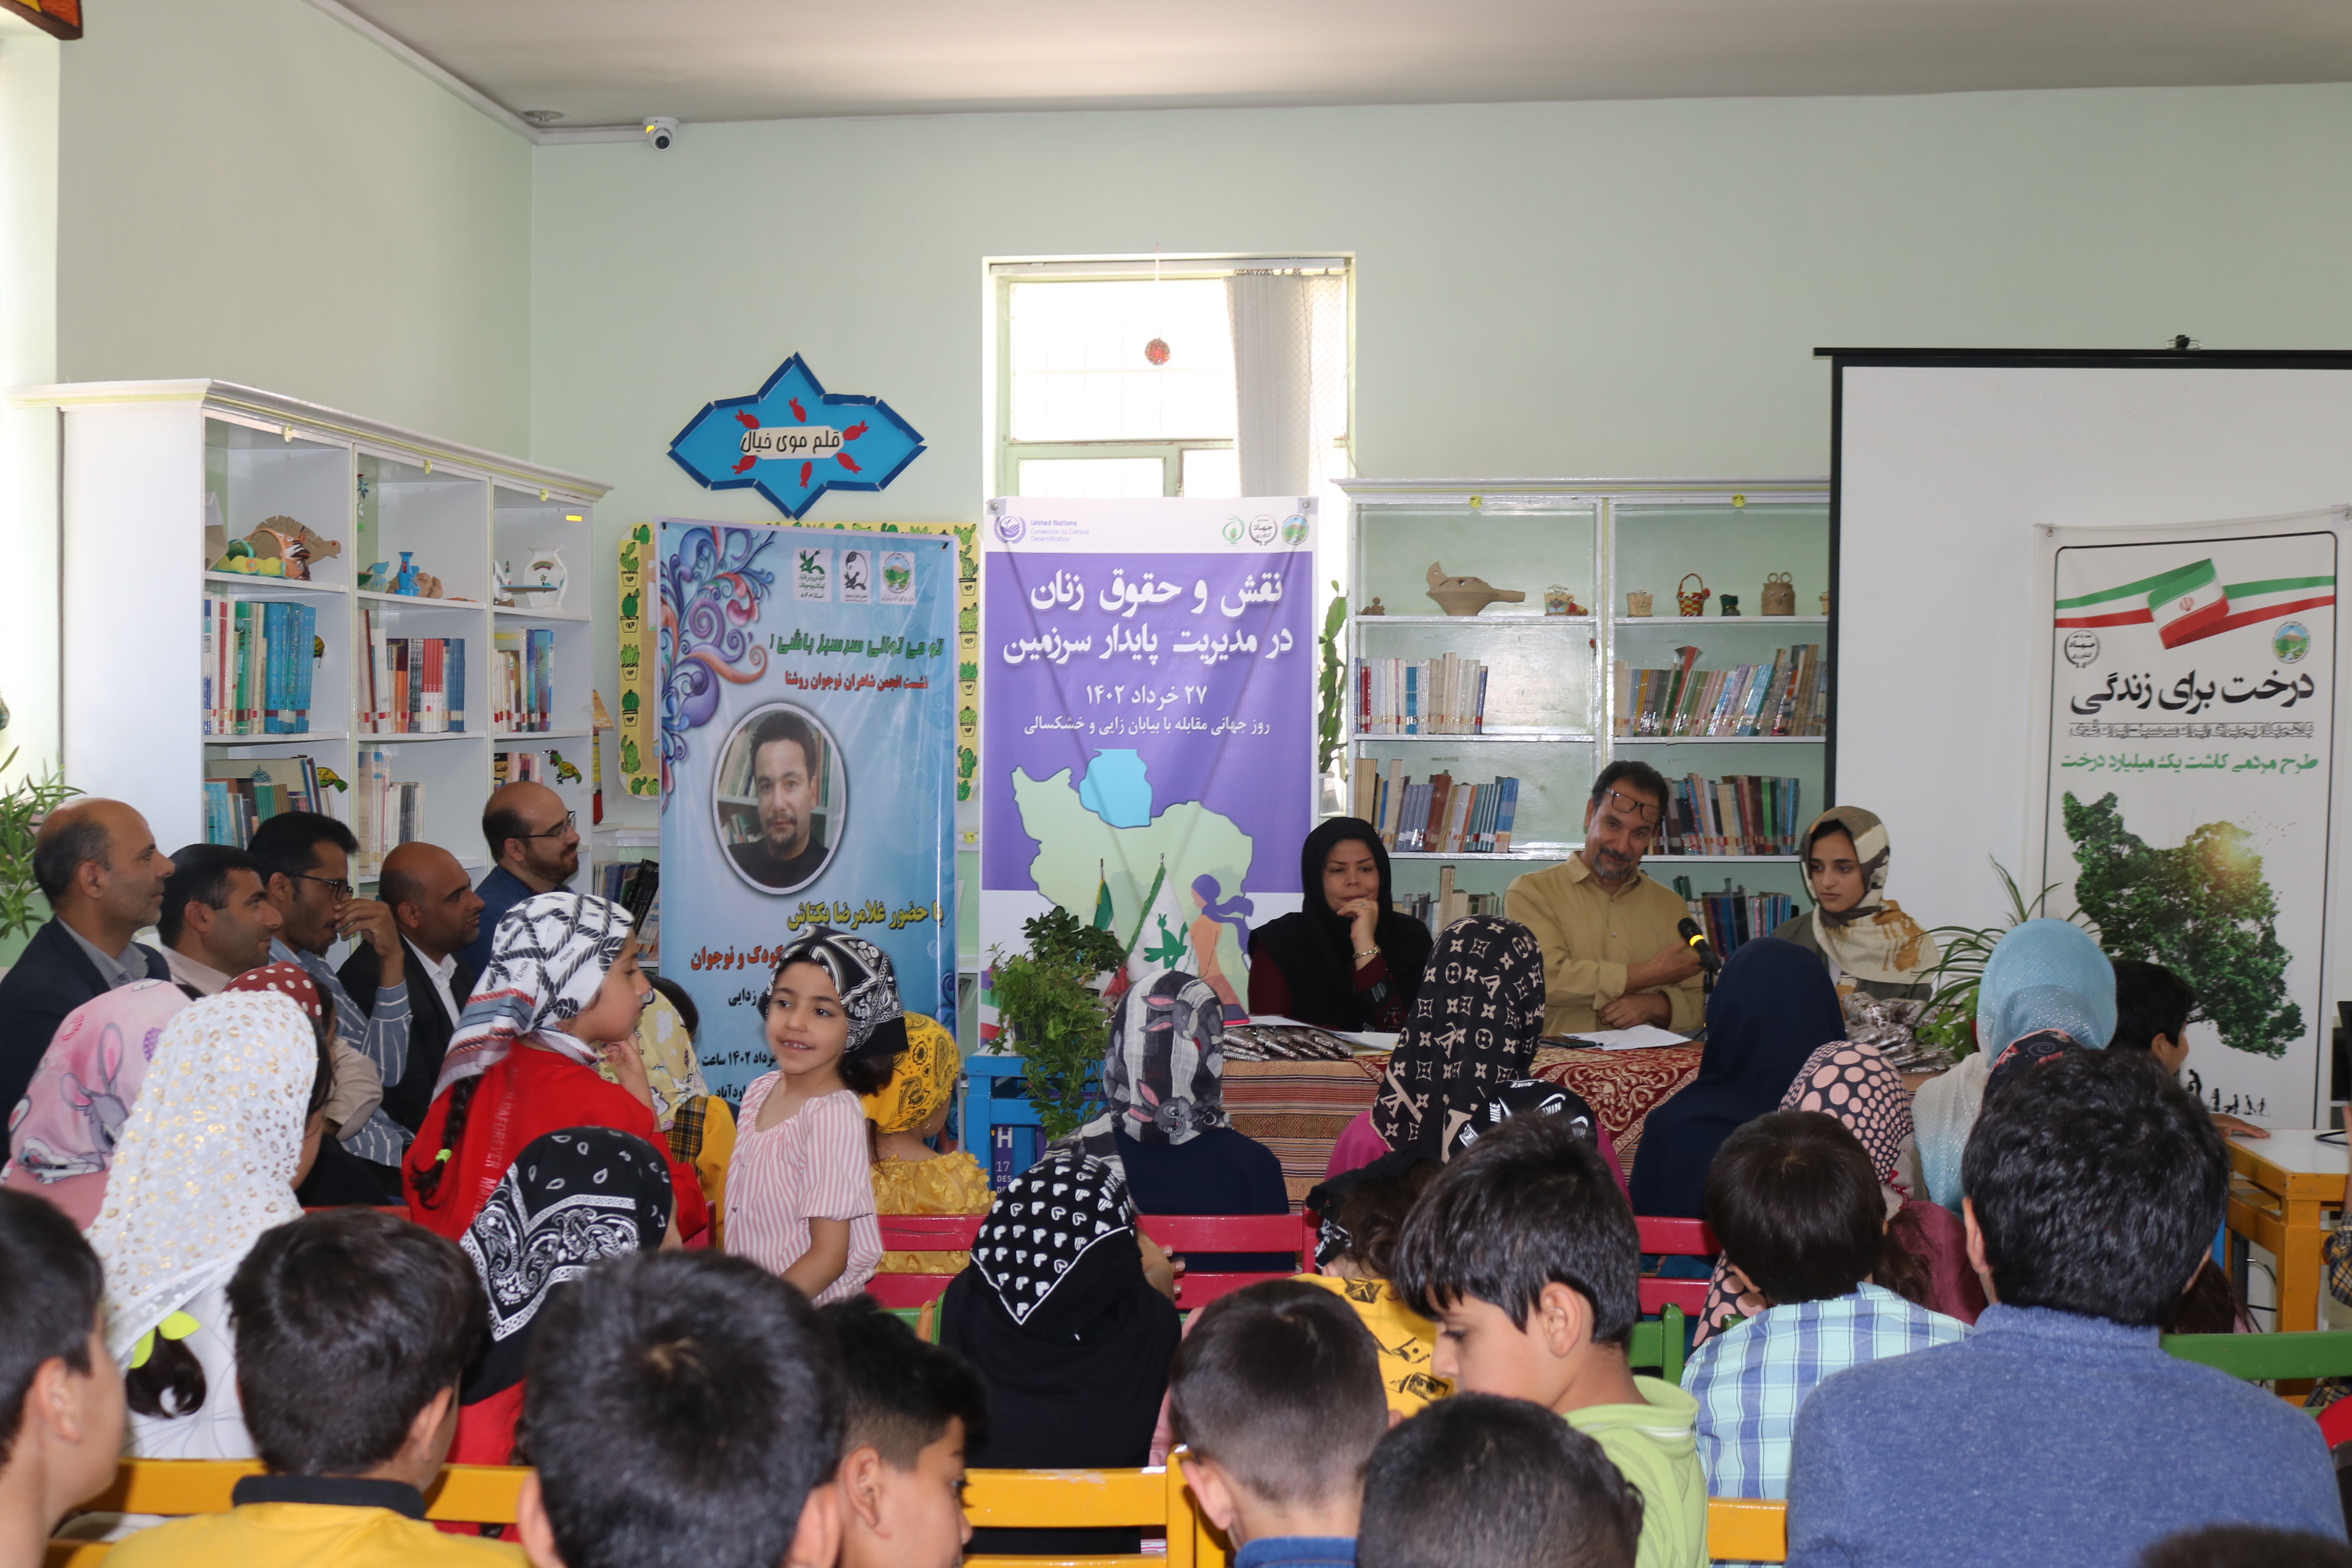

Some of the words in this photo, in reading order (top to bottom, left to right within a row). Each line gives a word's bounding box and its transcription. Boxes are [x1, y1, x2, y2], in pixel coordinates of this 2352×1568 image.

[740, 431, 771, 452] خیال
[812, 430, 839, 453] قلم
[1031, 569, 1085, 610] زنان
[1099, 569, 1182, 617] حقوق
[1191, 579, 1208, 614] و
[1221, 572, 1282, 617] نقش
[777, 629, 814, 656] باشی
[816, 633, 863, 656] سرسبز
[867, 636, 904, 657] توانی
[929, 638, 944, 659] تو
[1003, 626, 1092, 664] سرزمین
[1099, 622, 1158, 665] پایدار
[1173, 629, 1258, 665] مدیریت
[1265, 628, 1293, 659] در
[785, 670, 809, 690] روشنا
[811, 672, 842, 691] نوجوان
[844, 673, 876, 691] شاعران
[877, 674, 902, 691] انجمن
[903, 675, 929, 690] نشست
[2222, 669, 2314, 708] درخت
[1086, 684, 1125, 705] ۱۴۰۲
[1131, 684, 1180, 711] خرداد
[1184, 685, 1208, 705] ۲۷
[2071, 672, 2152, 716] زندگی
[2158, 669, 2216, 715] برای
[1024, 714, 1086, 736] خشکسالی
[1089, 721, 1096, 735] و
[1098, 716, 1125, 736] زایی
[1128, 716, 1159, 736] بیابان
[1163, 716, 1171, 736] با
[1175, 715, 1208, 731] مقابله
[1210, 716, 1247, 736] جهانی
[1250, 717, 1270, 736] روز
[2061, 753, 2105, 772] درخت
[2109, 753, 2155, 773] میلیارد
[2157, 753, 2182, 772] یک
[2185, 753, 2229, 769] کاشت
[2232, 755, 2276, 775] مردمی
[2280, 753, 2318, 774] طرح
[787, 901, 830, 930] بکتاش
[888, 901, 928, 930] حضور
[932, 900, 944, 927] با
[559, 946, 576, 963] FENDI
[690, 946, 735, 971] نوجوان
[737, 953, 744, 970] و
[514, 960, 530, 982] FENDI
[728, 987, 757, 1007] زدایی
[701, 1052, 726, 1067] ساعت
[728, 1050, 750, 1066] ۱۴۰۲
[1489, 1102, 1501, 1123] NIKE
[995, 1161, 1010, 1172] 17
